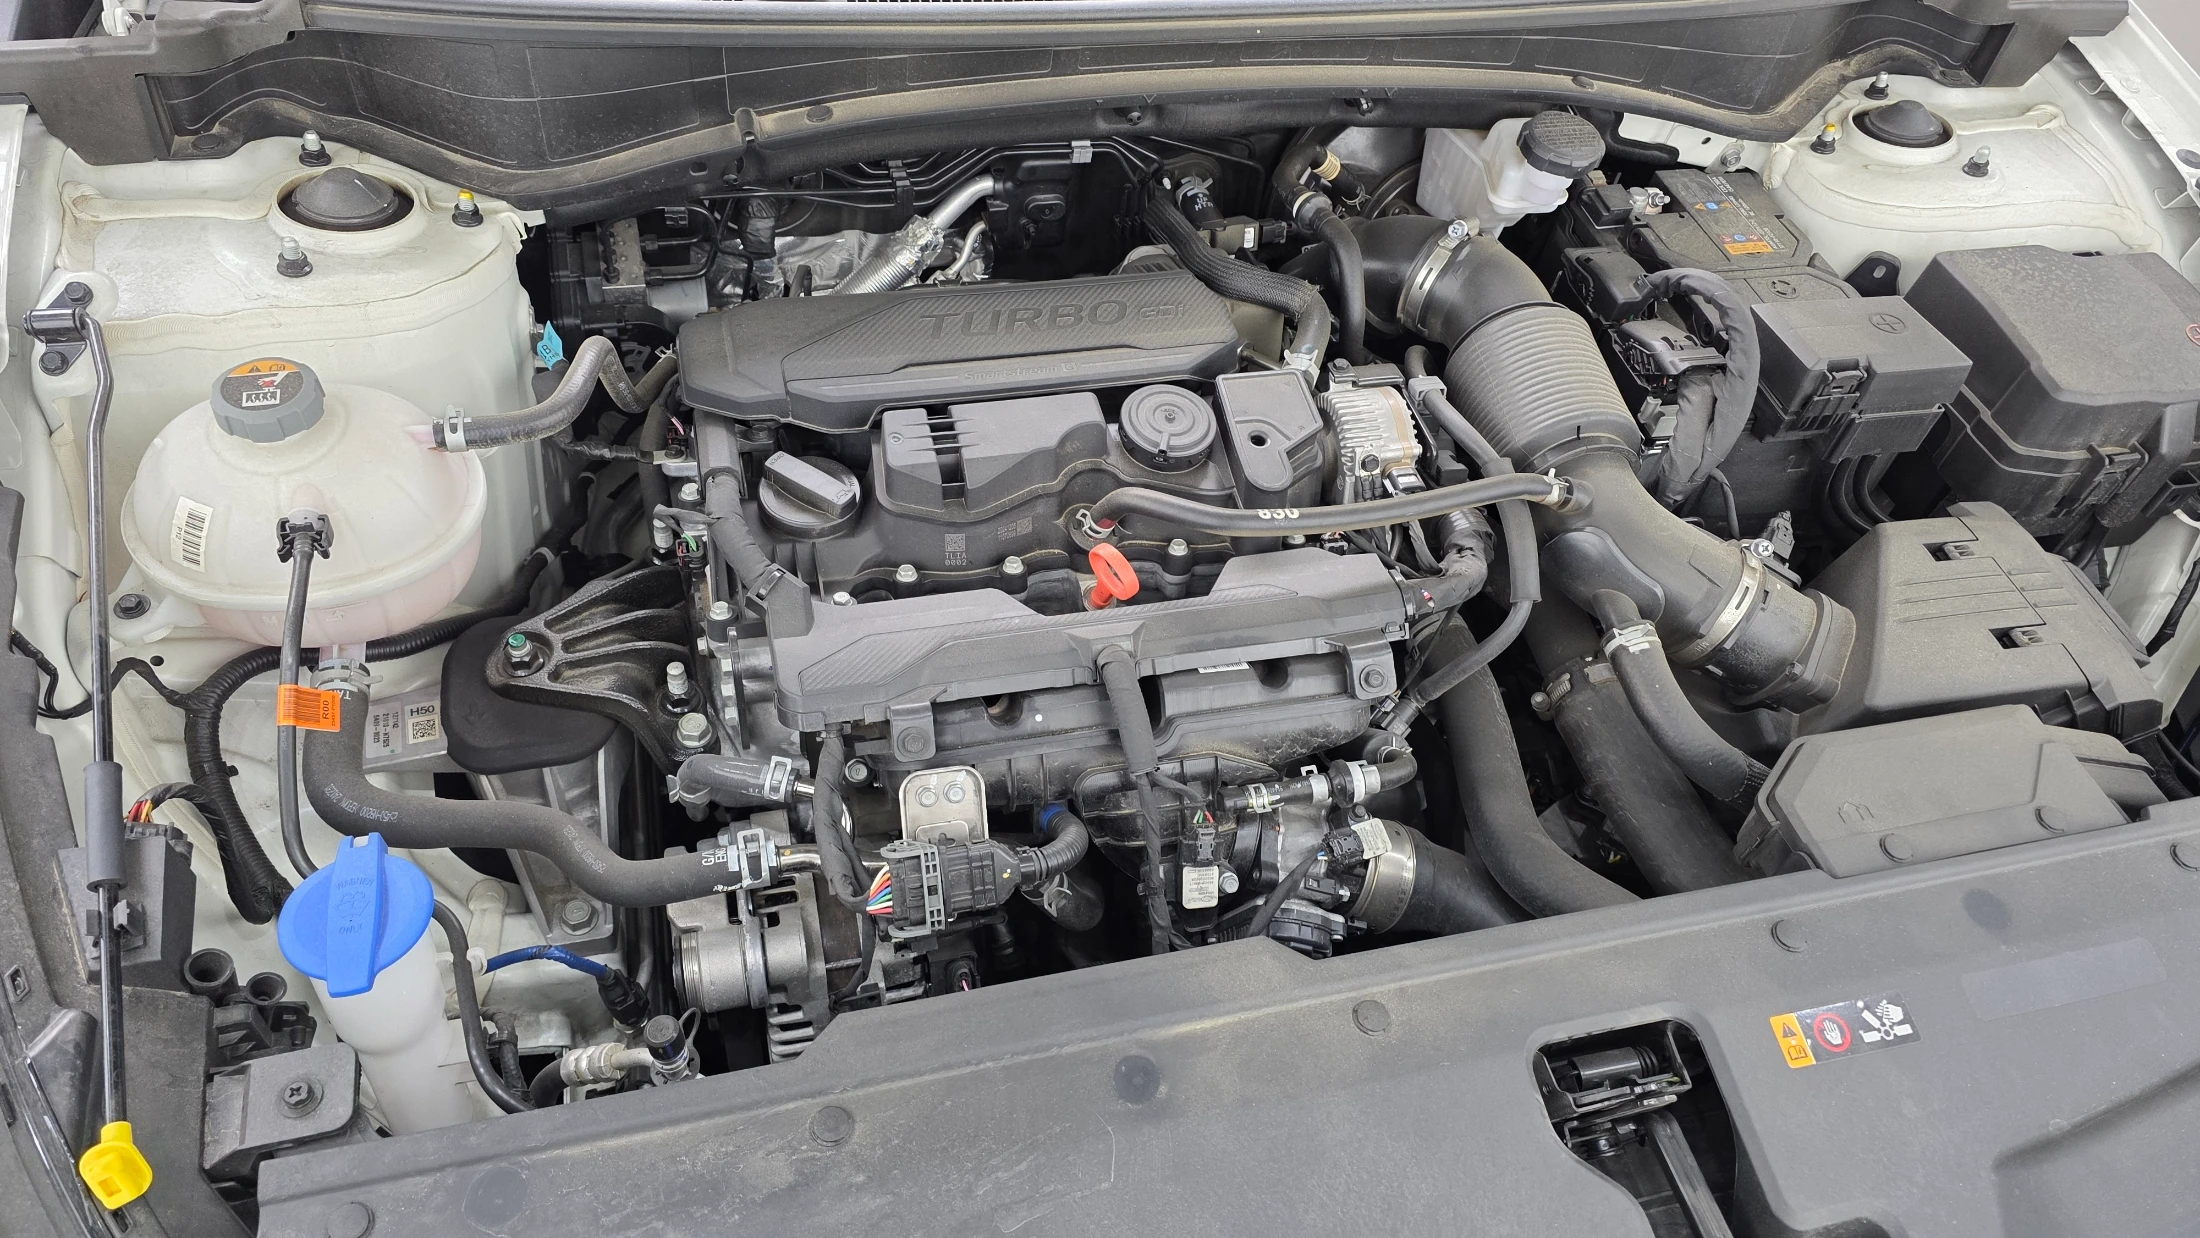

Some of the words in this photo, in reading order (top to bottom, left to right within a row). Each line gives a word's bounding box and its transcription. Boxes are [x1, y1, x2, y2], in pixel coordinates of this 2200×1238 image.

[1194, 201, 1214, 212] HTR
[920, 300, 1128, 339] TURBO
[963, 365, 1058, 381] Smartstream
[321, 700, 330, 720] R00
[410, 705, 435, 717] H50
